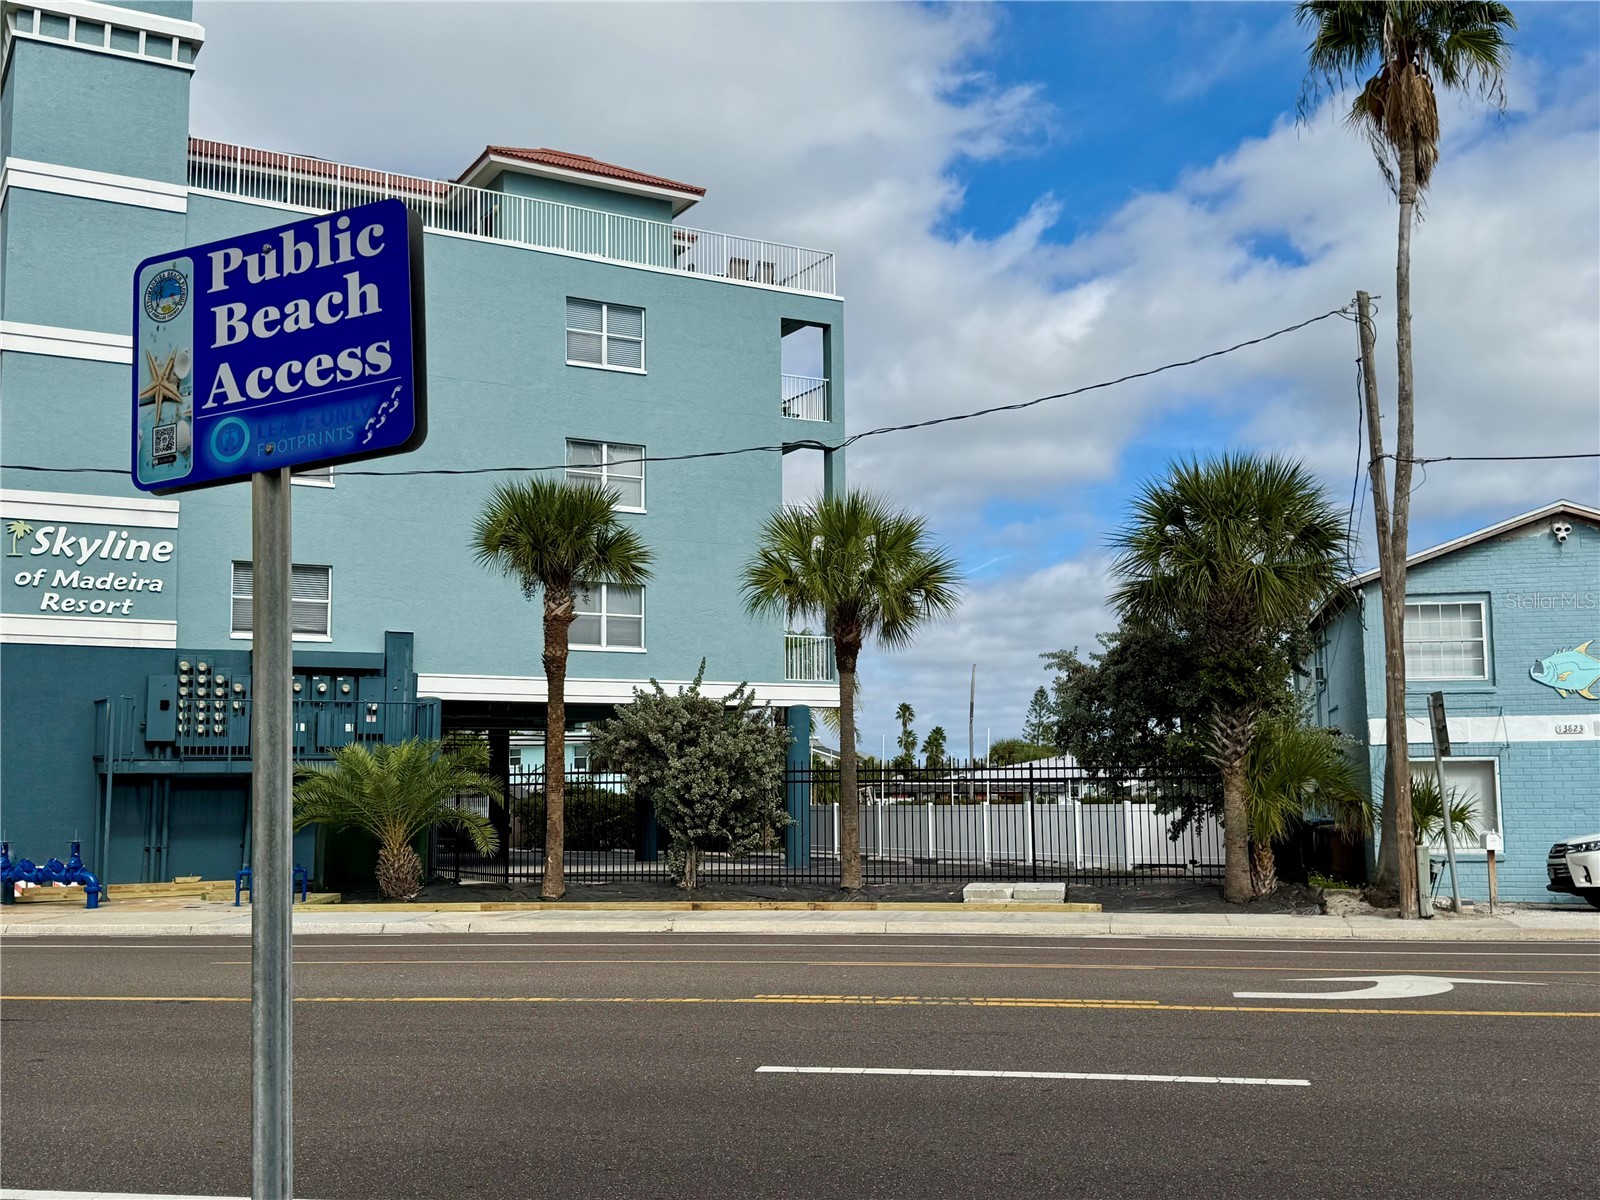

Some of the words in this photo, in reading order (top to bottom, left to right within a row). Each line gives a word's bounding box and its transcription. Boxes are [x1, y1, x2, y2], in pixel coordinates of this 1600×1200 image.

[206, 215, 386, 294] Public
[210, 271, 383, 348] Beach
[202, 340, 392, 409] Access
[320, 400, 371, 427] ONLY
[257, 425, 355, 457] FOOTPRINTS
[30, 526, 174, 565] Skyline
[14, 568, 47, 587] of
[51, 569, 163, 592] Madeira
[40, 592, 133, 615] Resort
